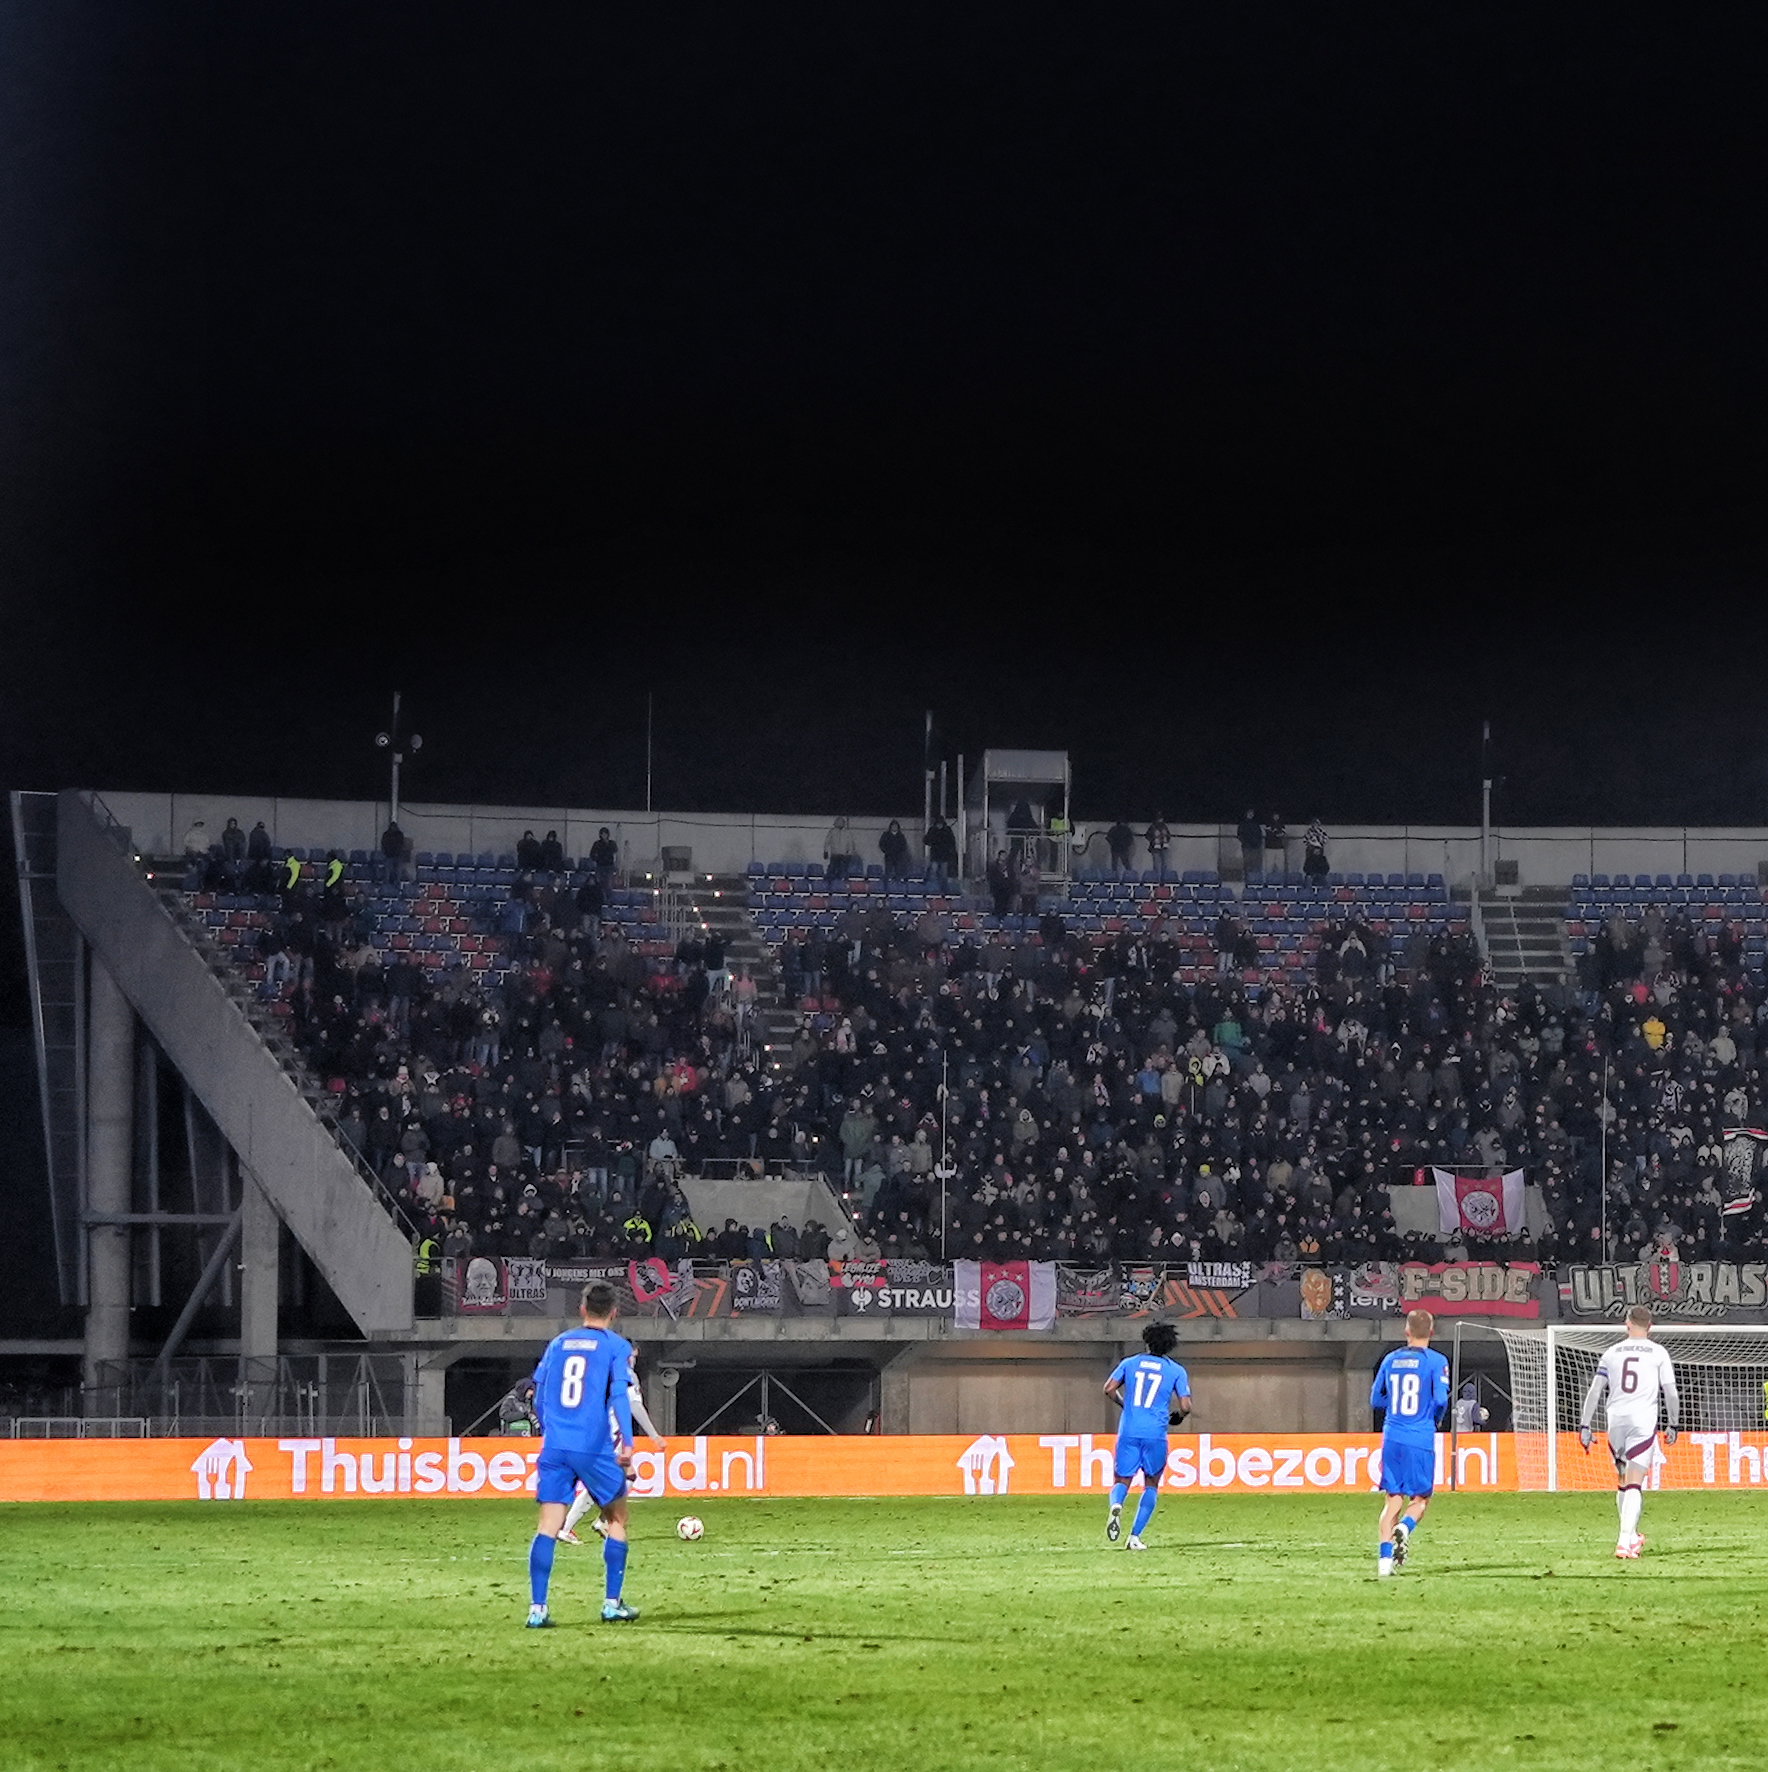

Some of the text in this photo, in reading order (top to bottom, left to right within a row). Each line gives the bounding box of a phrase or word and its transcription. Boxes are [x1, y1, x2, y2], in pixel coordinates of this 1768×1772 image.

[1187, 1261, 1242, 1277] ULTRAS
[1189, 1275, 1241, 1288] AMSTERDAM
[1404, 1265, 1531, 1303] F-SIDE
[509, 1287, 546, 1300] ULTRAS
[560, 1355, 587, 1409] 8
[1133, 1371, 1163, 1409] 17
[1389, 1373, 1420, 1416] 18
[1621, 1357, 1639, 1394] 6
[278, 1436, 765, 1498] Thuisbegd.nl
